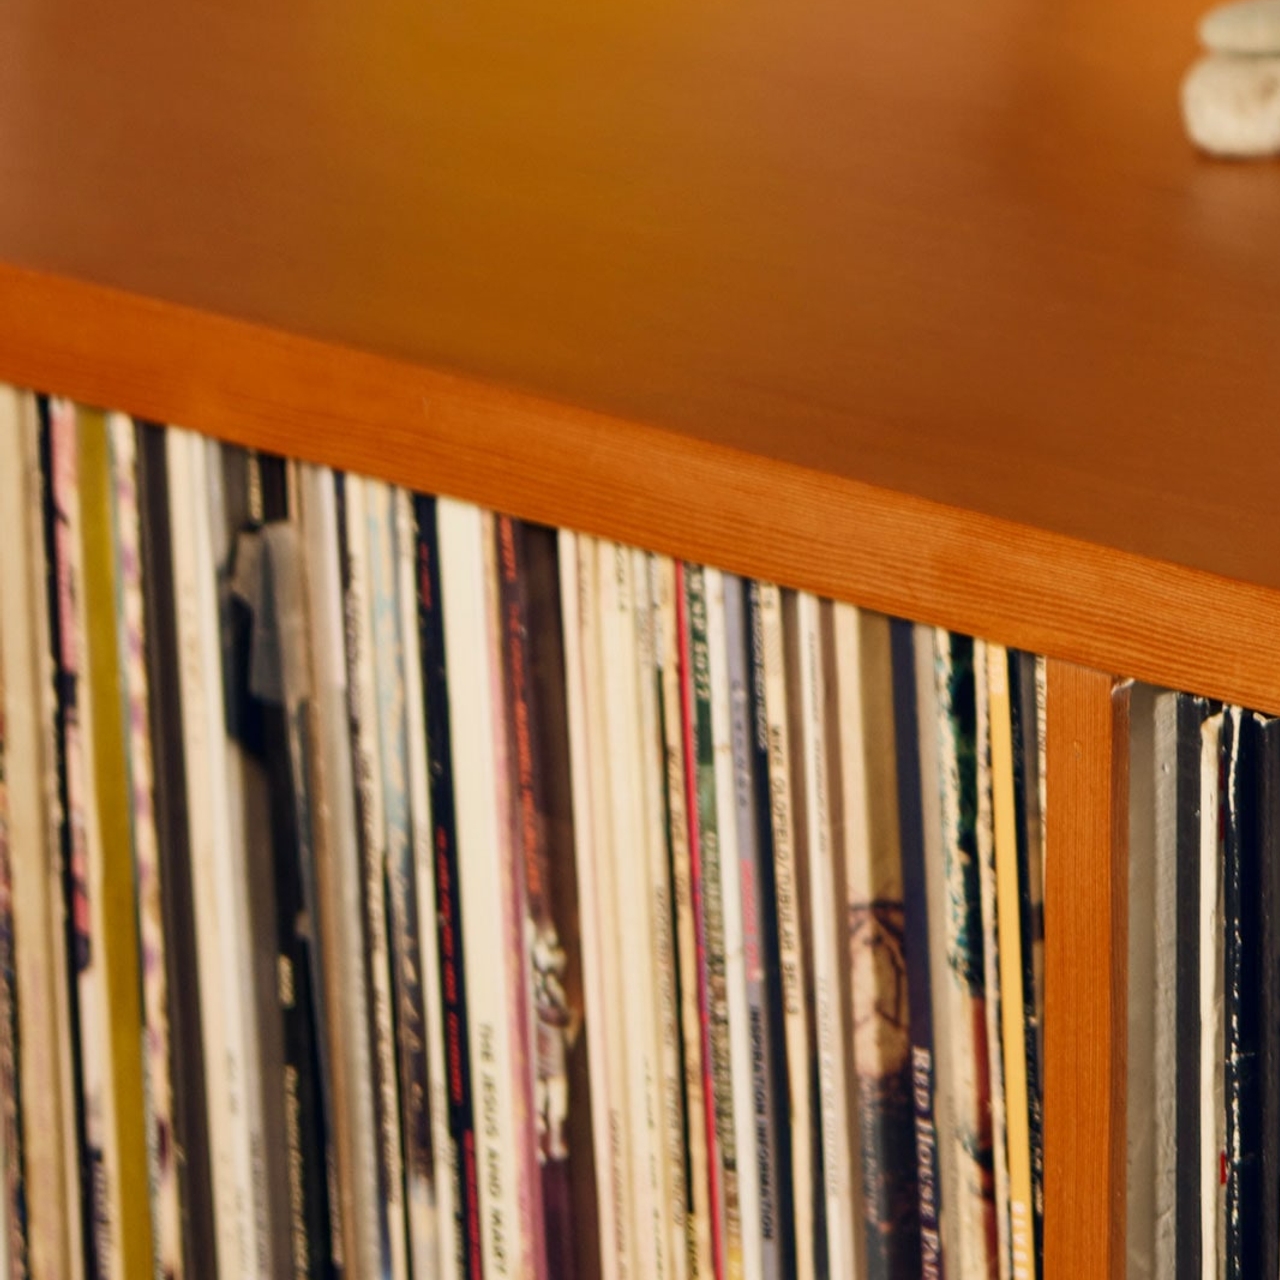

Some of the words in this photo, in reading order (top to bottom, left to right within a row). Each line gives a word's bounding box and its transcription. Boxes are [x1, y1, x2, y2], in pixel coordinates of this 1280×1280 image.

[770, 725, 784, 766] MIKE
[783, 960, 800, 1014] BELLS
[482, 1022, 499, 1064] THE
[752, 1004, 767, 1115] INSPIRATION
[911, 1045, 932, 1111] RED
[484, 1071, 502, 1138] JESUS
[488, 1146, 505, 1197] AND
[757, 1119, 775, 1240] INFORMATION
[914, 1115, 936, 1219] HOUSE
[492, 1204, 508, 1276] MARY
